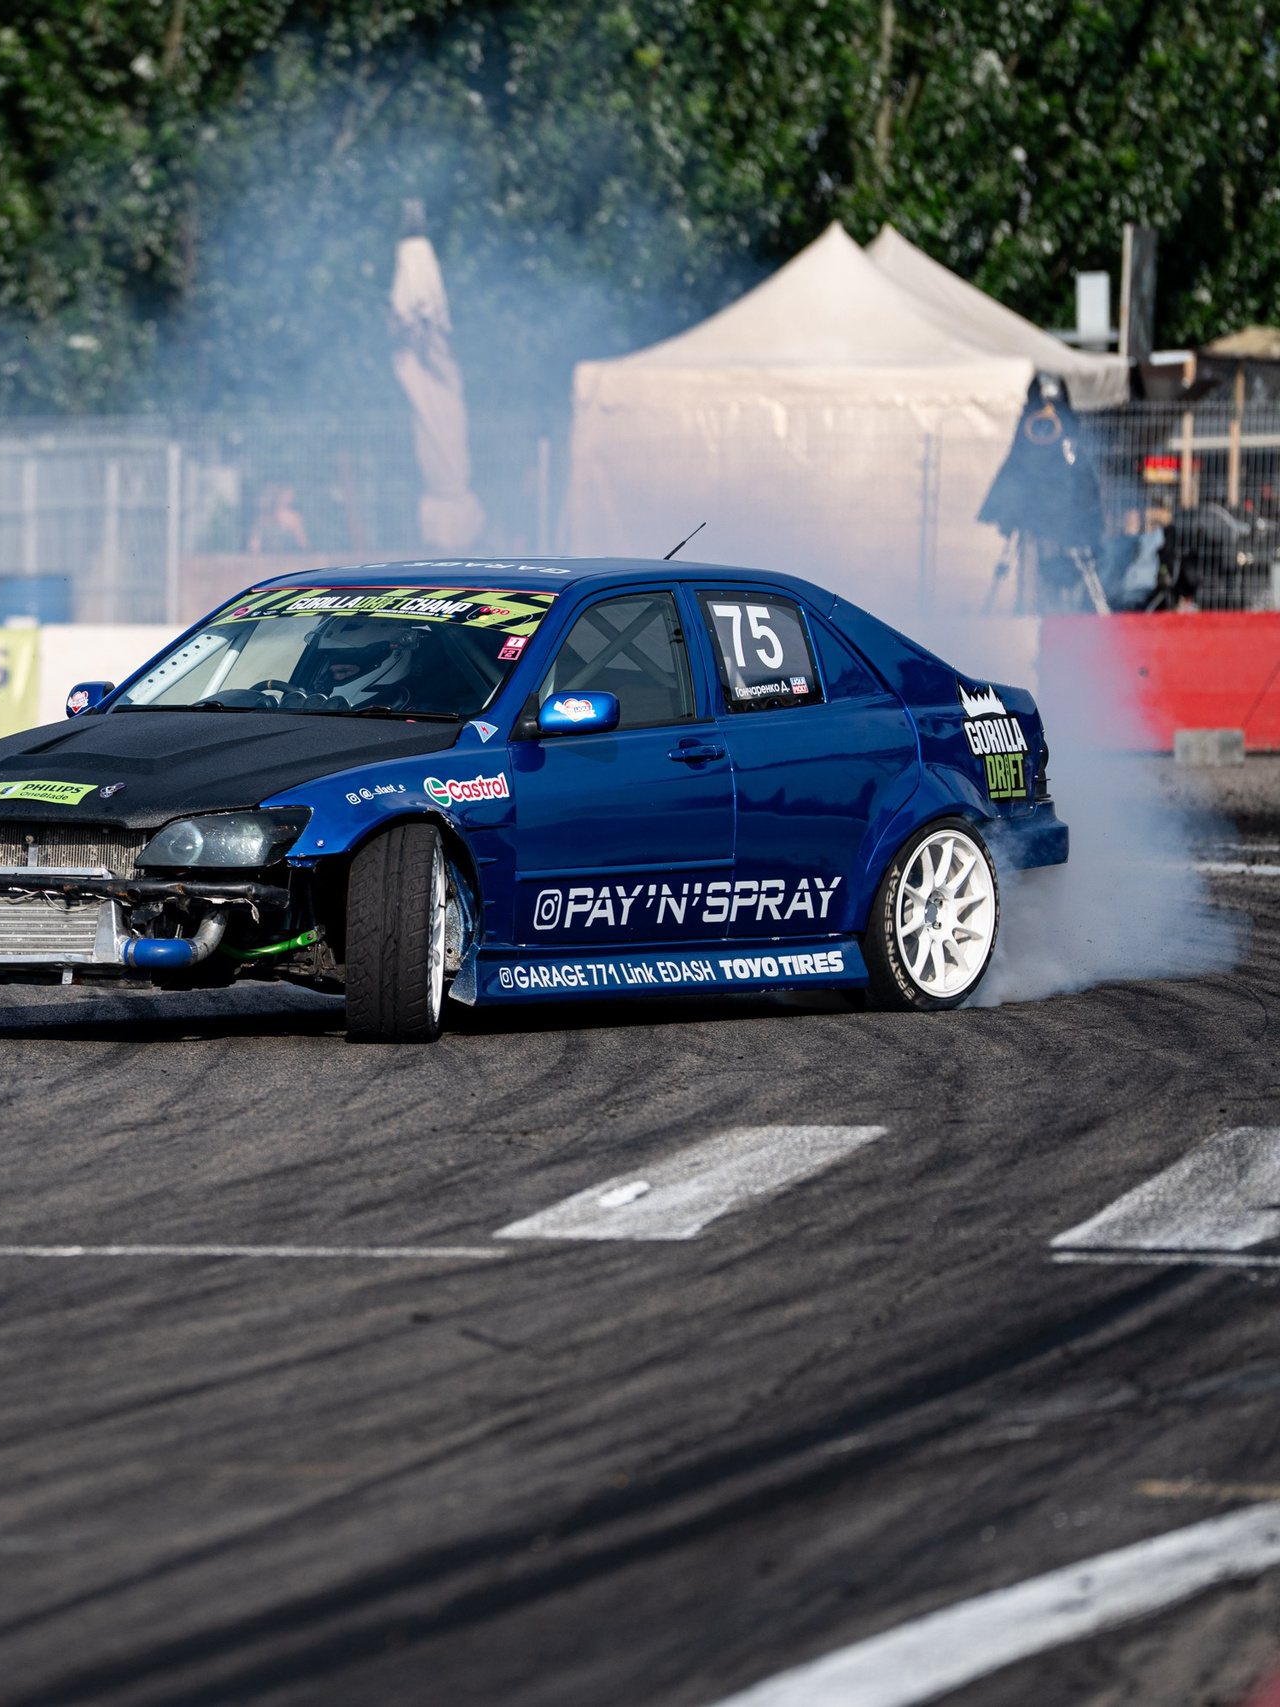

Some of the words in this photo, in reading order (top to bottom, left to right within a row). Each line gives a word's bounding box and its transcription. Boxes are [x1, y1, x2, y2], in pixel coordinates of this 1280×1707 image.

[713, 604, 784, 669] 75
[735, 683, 780, 697] Гончаренко
[964, 718, 1028, 755] GORILLA
[22, 783, 84, 793] PHILIPS
[448, 776, 508, 799] Castrol
[985, 753, 1026, 799] DRIFT
[20, 791, 69, 800] OneBlade
[564, 876, 842, 928] PAY'N'SPRAY
[514, 965, 589, 989] GARAGE
[587, 963, 621, 985] 771
[620, 962, 659, 984] Link
[656, 960, 717, 983] EDASH
[719, 956, 780, 980] TOYO
[778, 950, 845, 976] TIRES
